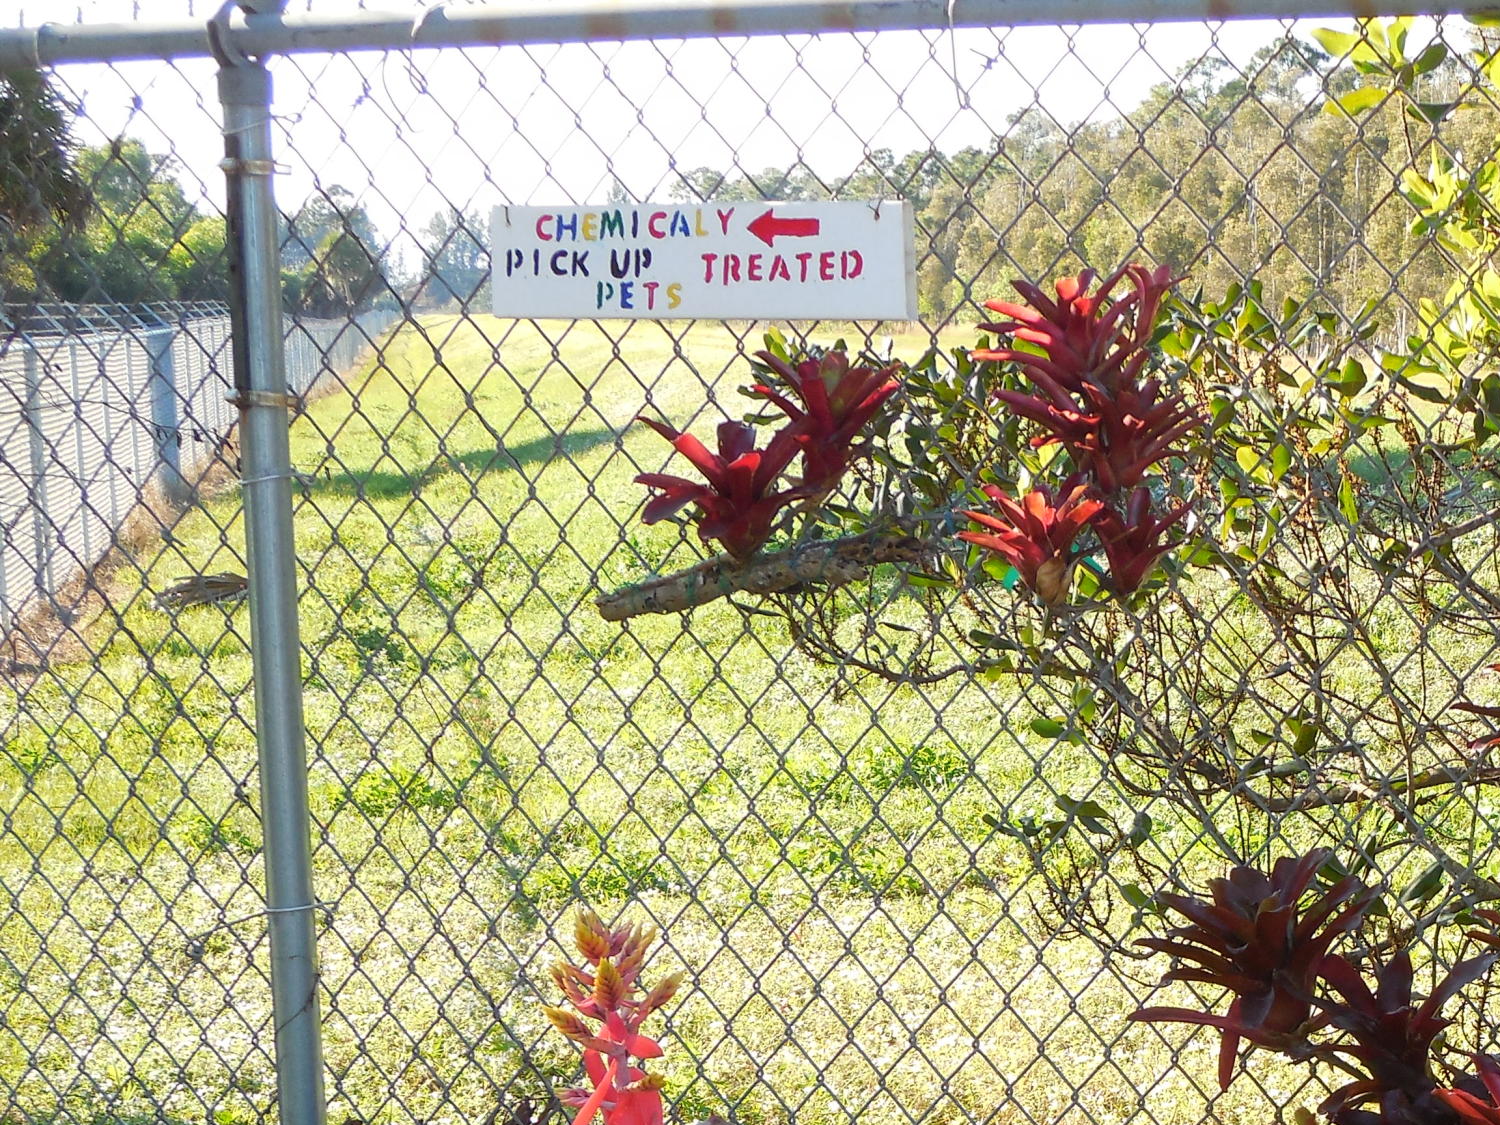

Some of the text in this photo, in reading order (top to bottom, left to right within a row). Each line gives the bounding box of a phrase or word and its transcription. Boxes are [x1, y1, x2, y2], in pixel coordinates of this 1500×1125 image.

[535, 206, 735, 241] CHEMICALY
[506, 248, 652, 279] PICK UP
[701, 249, 864, 286] TREATED
[597, 280, 682, 311] PETS
